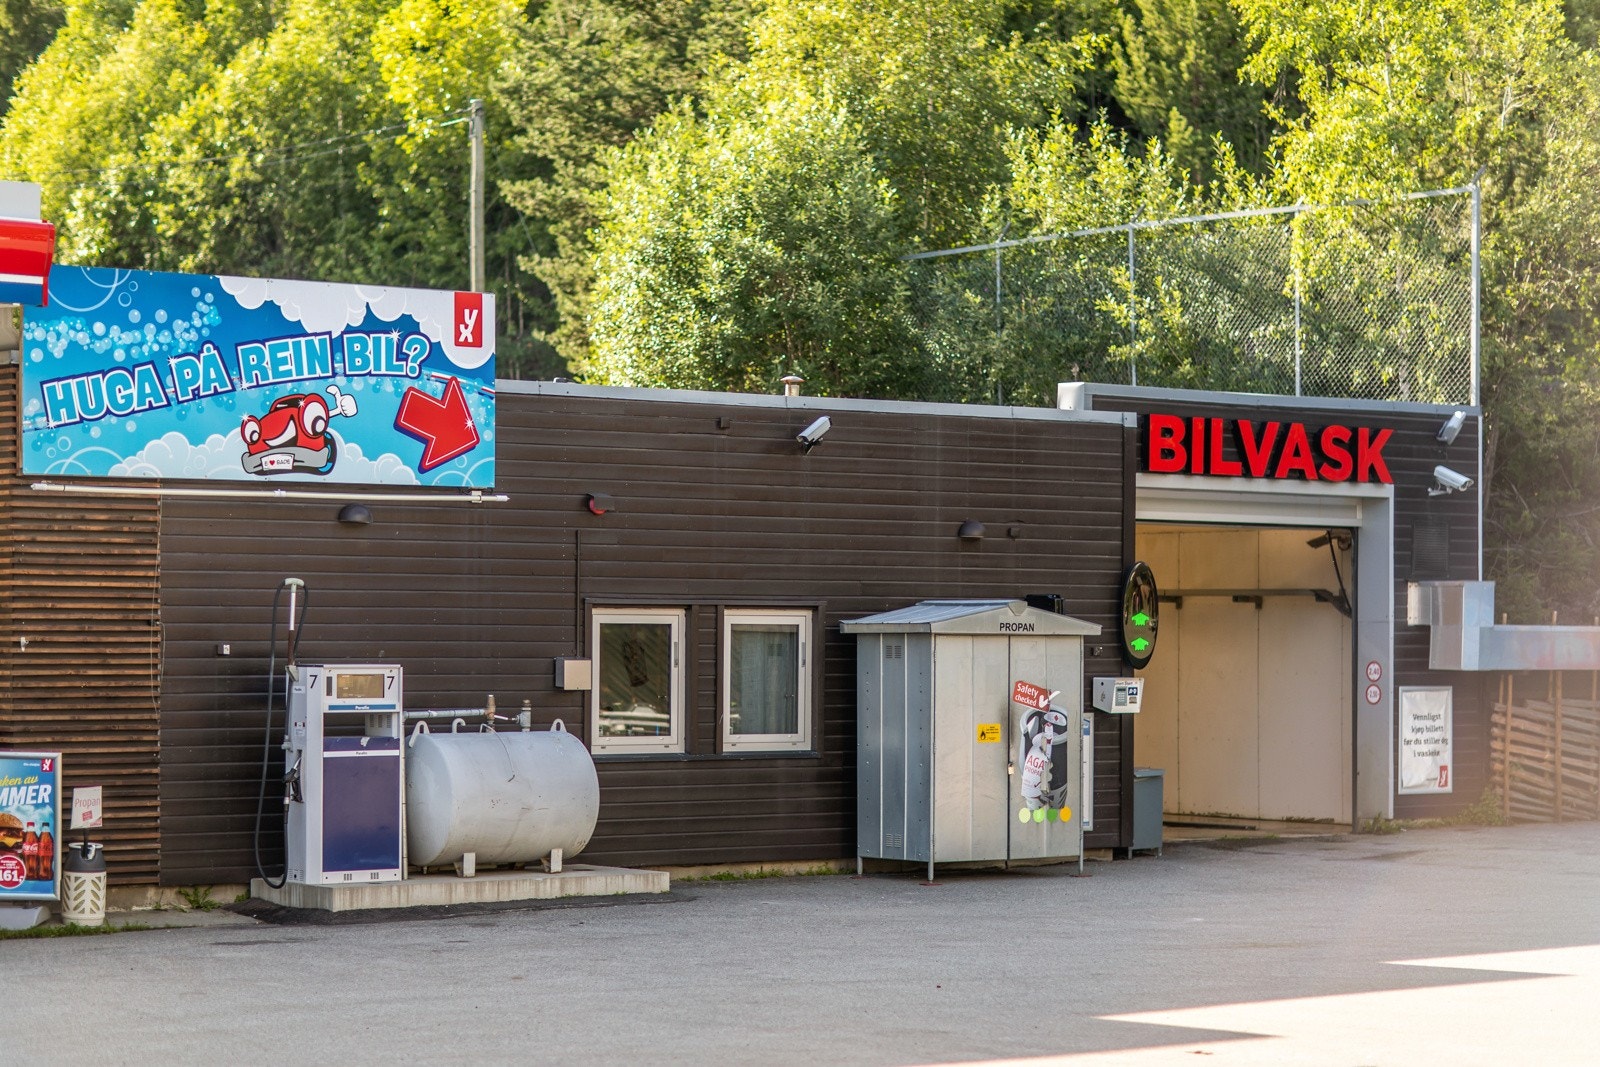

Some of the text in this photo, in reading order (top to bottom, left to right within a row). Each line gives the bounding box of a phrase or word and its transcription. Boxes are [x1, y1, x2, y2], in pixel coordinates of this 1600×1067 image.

[42, 332, 431, 426] HUGA PÅ REIN BIL?
[1148, 413, 1394, 484] BILVASK
[999, 622, 1035, 632] PROPAN
[309, 674, 318, 689] 7
[386, 675, 395, 690] 7
[1016, 682, 1039, 698] Safety
[1014, 693, 1037, 707] checked
[1413, 713, 1441, 722] Vennligst
[1411, 725, 1444, 735] kjøp billett
[1027, 755, 1045, 771] AGA
[24, 775, 39, 785] av
[74, 797, 100, 809] Propan
